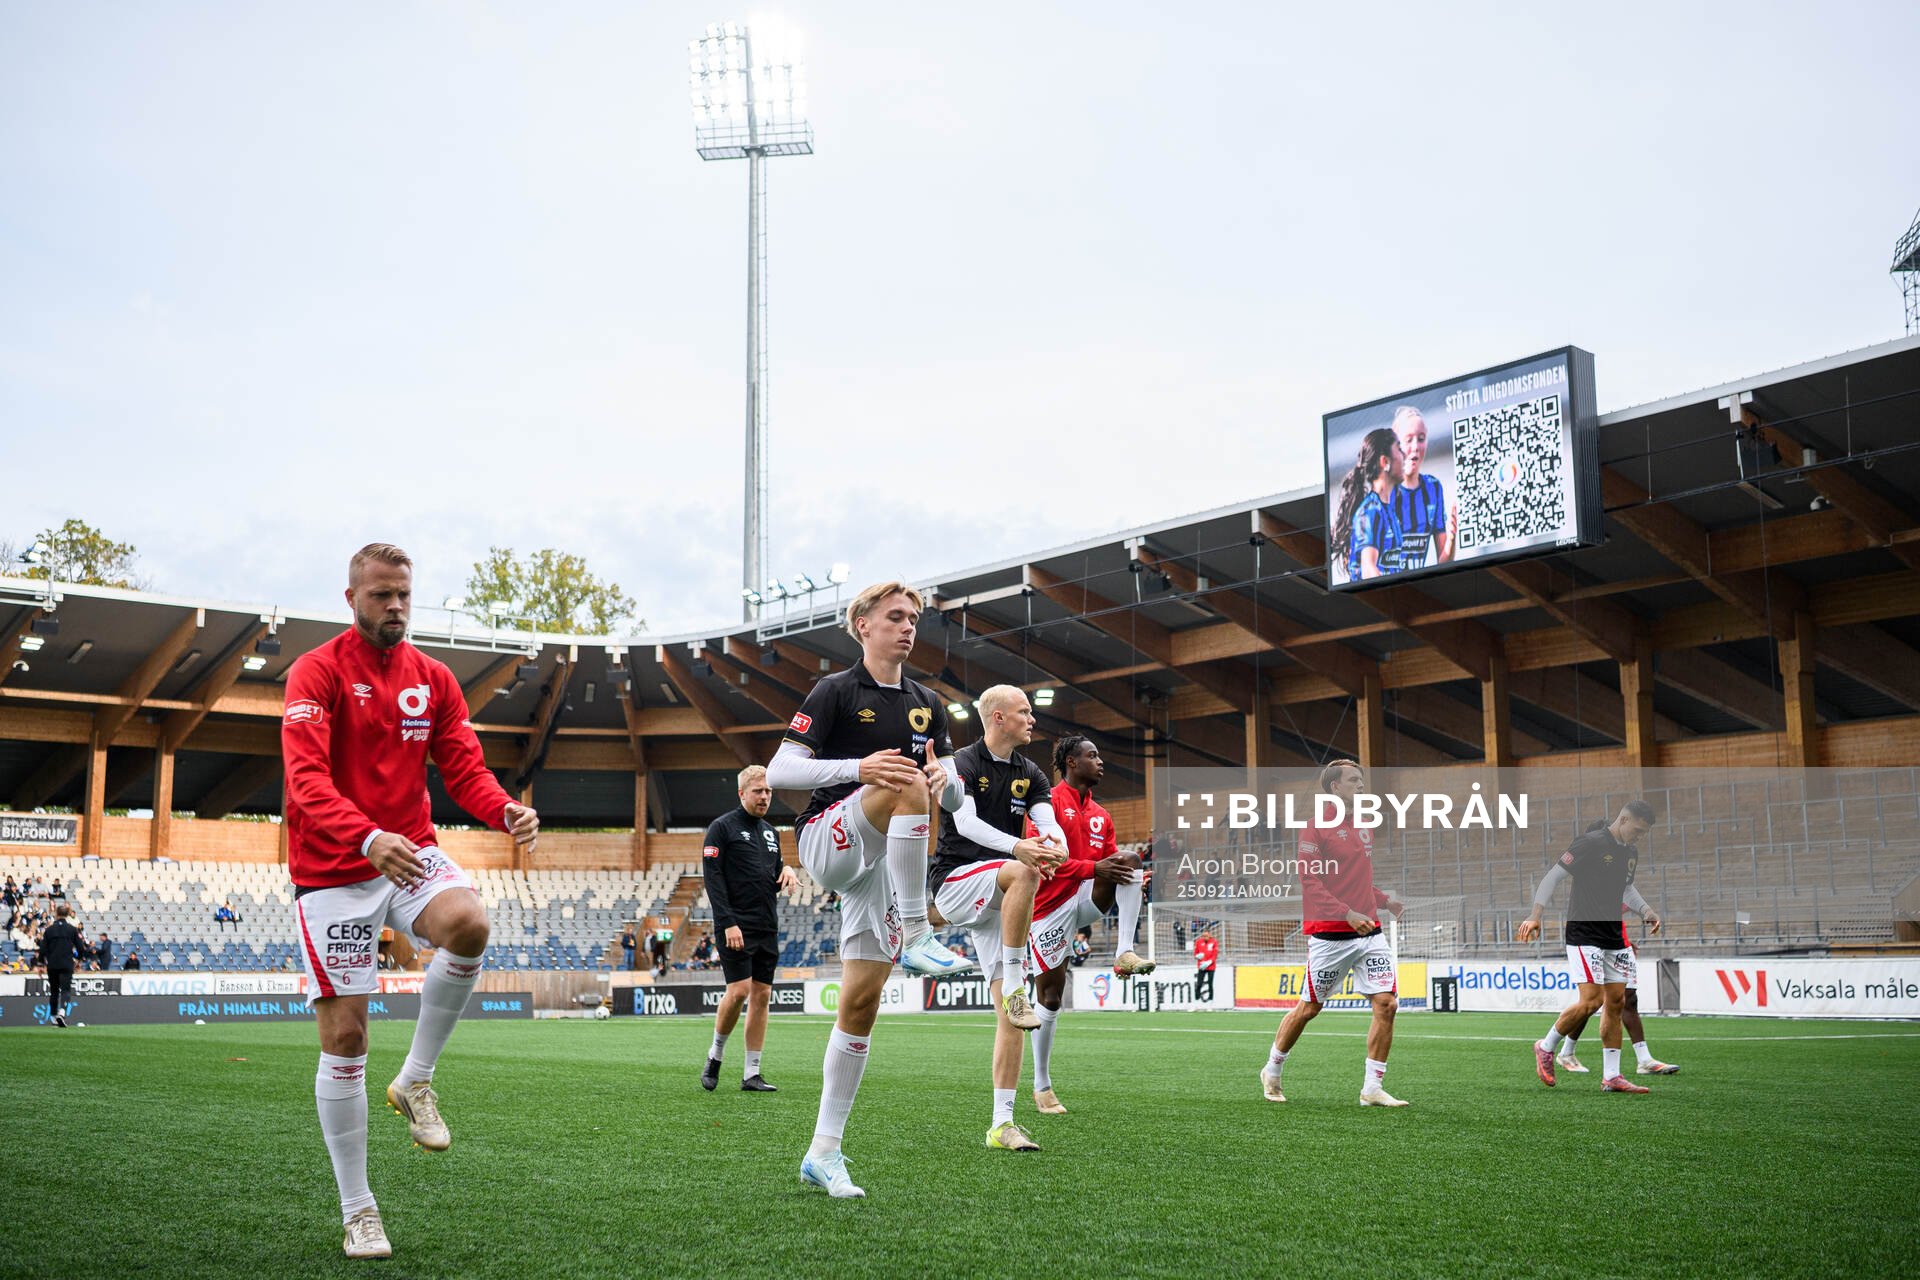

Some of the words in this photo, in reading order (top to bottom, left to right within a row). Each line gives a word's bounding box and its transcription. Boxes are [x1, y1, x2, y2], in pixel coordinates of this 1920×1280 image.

[1446, 389, 1480, 412] STÖTTA
[1482, 365, 1566, 403] UNGDOMSFONDEN
[2, 826, 69, 841] BILFORUM
[327, 924, 372, 940] CEOS
[1039, 926, 1064, 942] CEOS
[326, 954, 372, 967] D-LAB
[1366, 957, 1390, 967] CEOS
[342, 971, 351, 985] 6
[1317, 969, 1339, 979] CEOS
[1449, 966, 1570, 990] Handelsba
[1776, 978, 1855, 999] Vaksala
[1865, 977, 1919, 998] måle
[178, 1000, 219, 1015] FRÅN
[223, 1001, 284, 1015] HIMLEN.
[634, 987, 678, 1014] Brixo.
